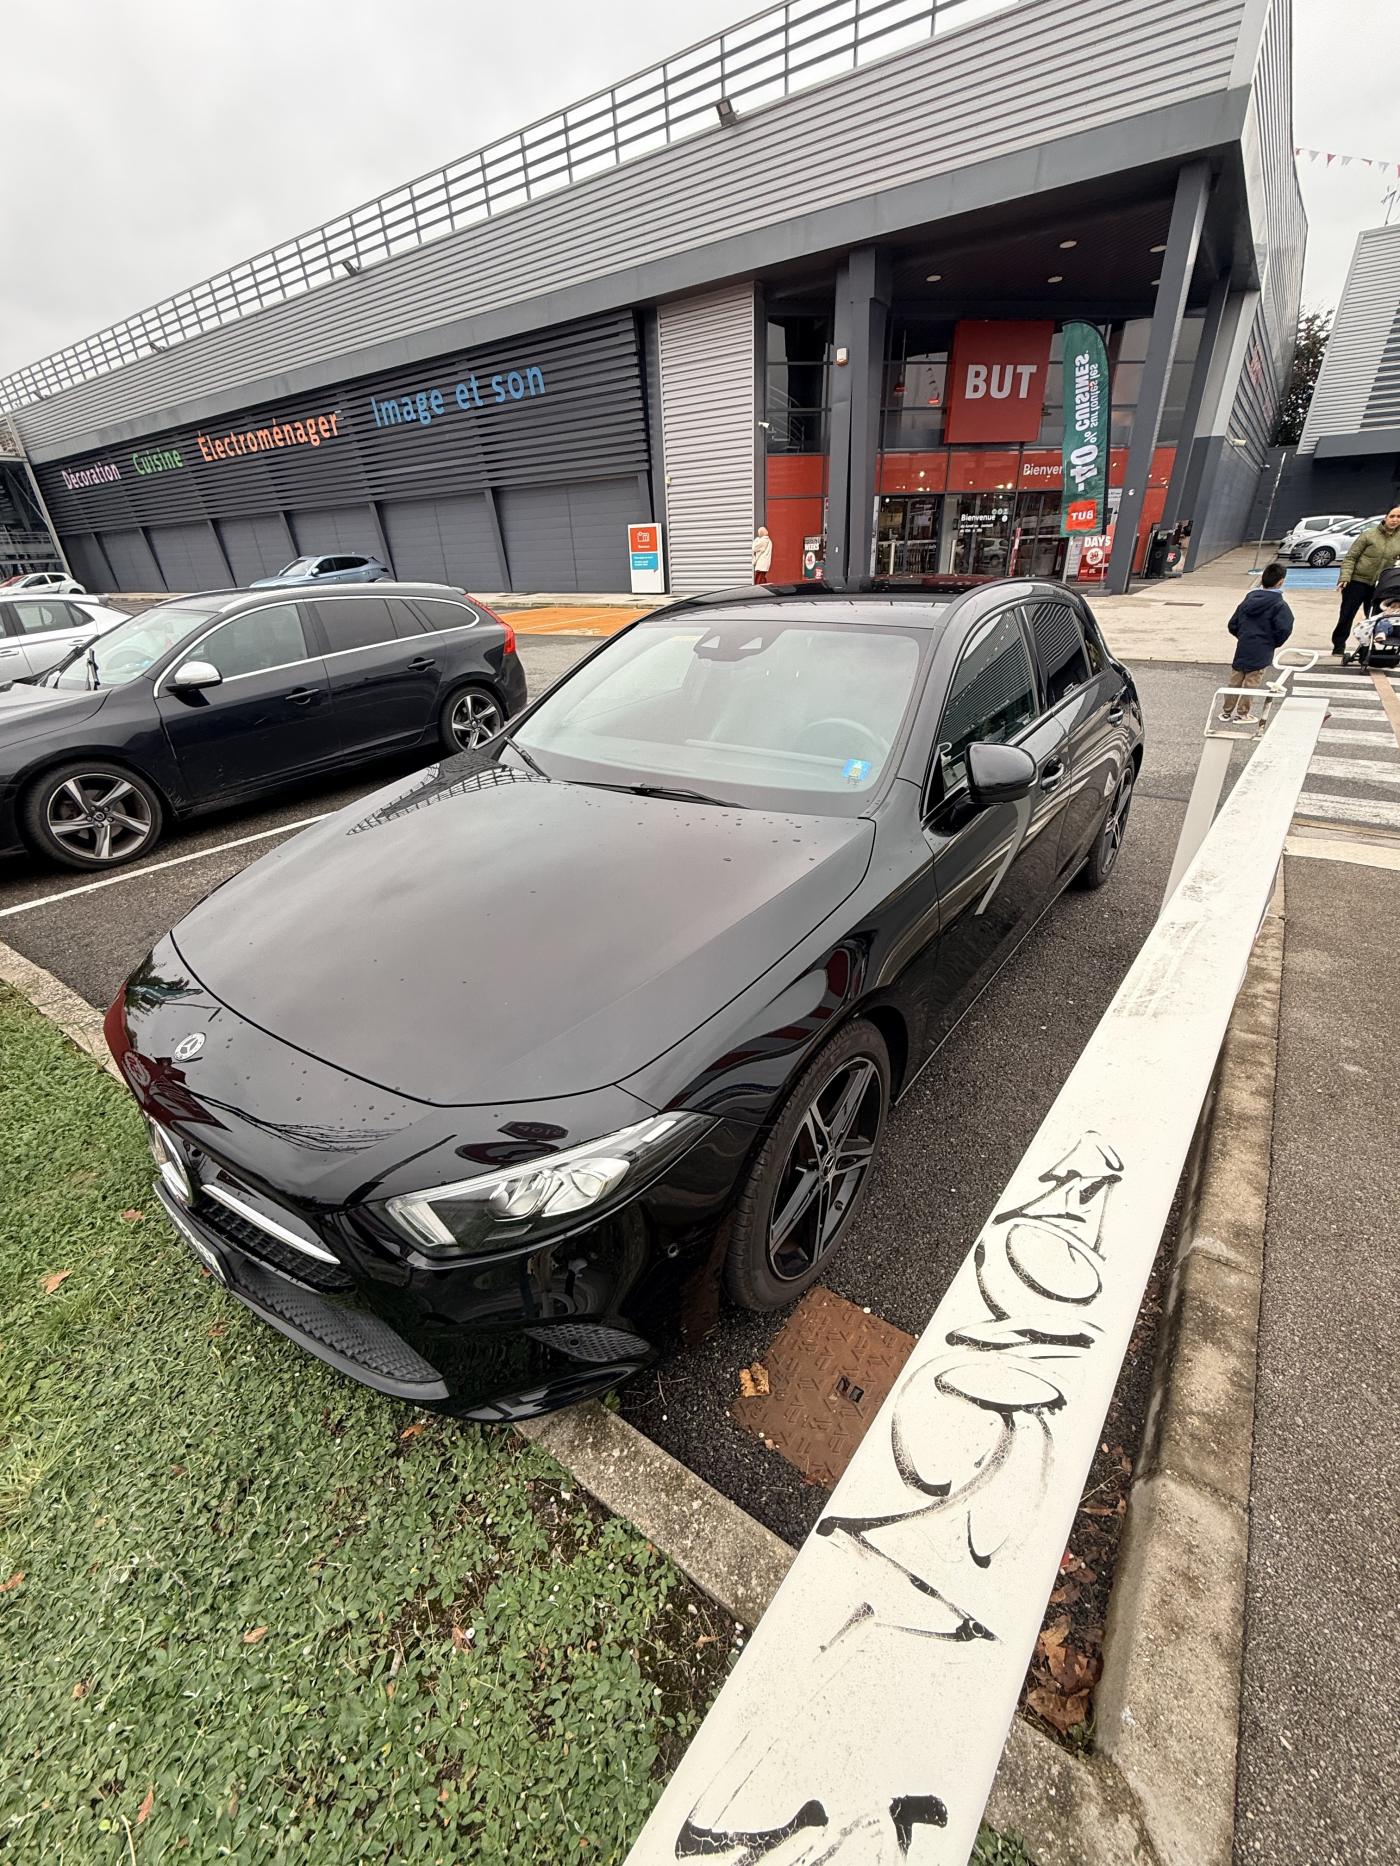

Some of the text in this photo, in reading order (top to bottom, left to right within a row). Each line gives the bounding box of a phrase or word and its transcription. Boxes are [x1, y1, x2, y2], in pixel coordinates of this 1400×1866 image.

[370, 366, 546, 427] Image et son
[965, 364, 1037, 399] BUT
[197, 412, 339, 462] Électroménager
[61, 462, 122, 490] Décoration
[132, 448, 184, 475] Cuisine
[1084, 535, 1112, 548] DAYS
